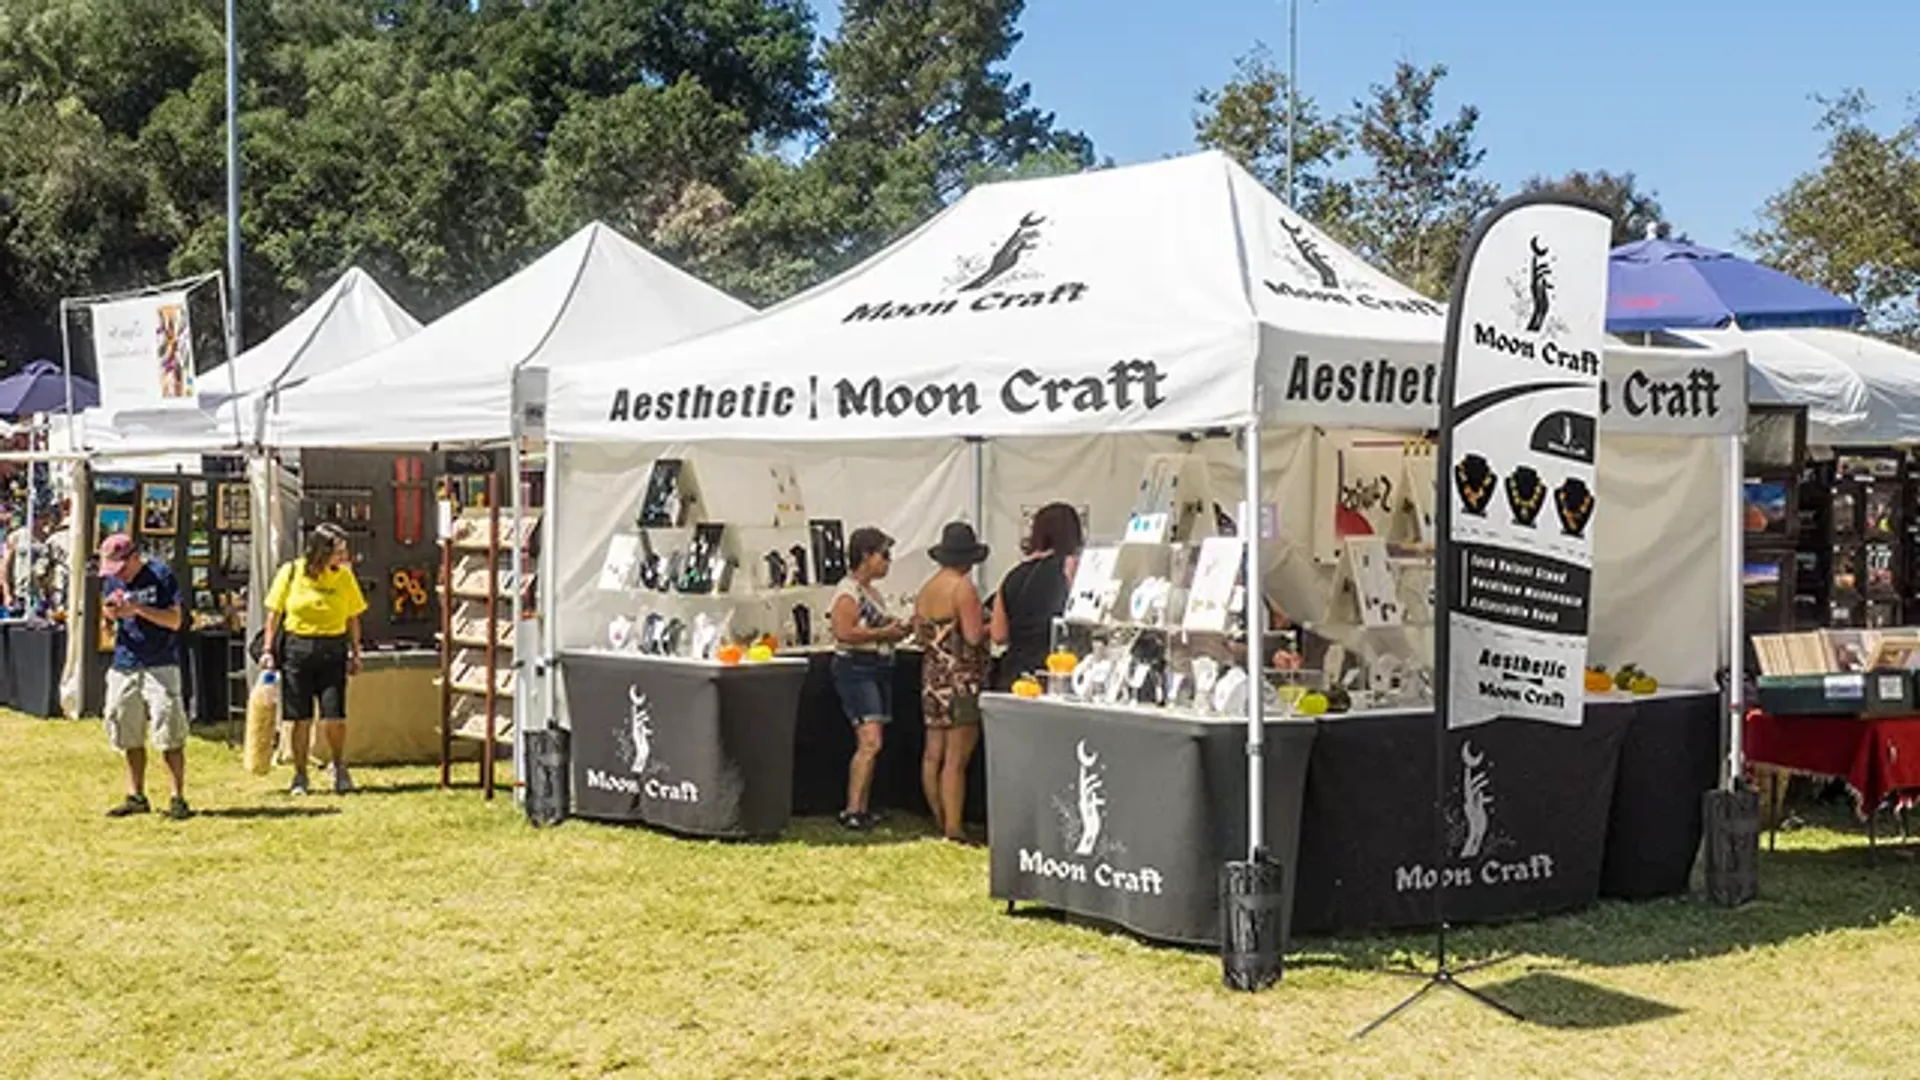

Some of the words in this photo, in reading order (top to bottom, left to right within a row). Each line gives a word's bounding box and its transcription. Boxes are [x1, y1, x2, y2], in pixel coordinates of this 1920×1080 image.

[841, 300, 958, 323] Moon
[970, 281, 1089, 312] Craft
[1263, 279, 1352, 306] Moon
[1356, 294, 1445, 317] Craft
[1474, 322, 1535, 359] Moon
[1542, 341, 1600, 376] Craft
[609, 381, 795, 421] Aesthetic
[834, 375, 981, 417] Moon
[1000, 358, 1167, 414] Craft
[1286, 355, 1442, 404] Aesthet
[1623, 367, 1721, 417] Craft
[1479, 648, 1567, 679] Aesthetic
[1479, 681, 1521, 700] Moon
[1524, 688, 1565, 709] Craft
[587, 768, 639, 793] Moon
[644, 778, 699, 802] Craft
[1019, 848, 1087, 882] Moon
[1094, 863, 1163, 895] Craft
[1481, 853, 1554, 884] Craft
